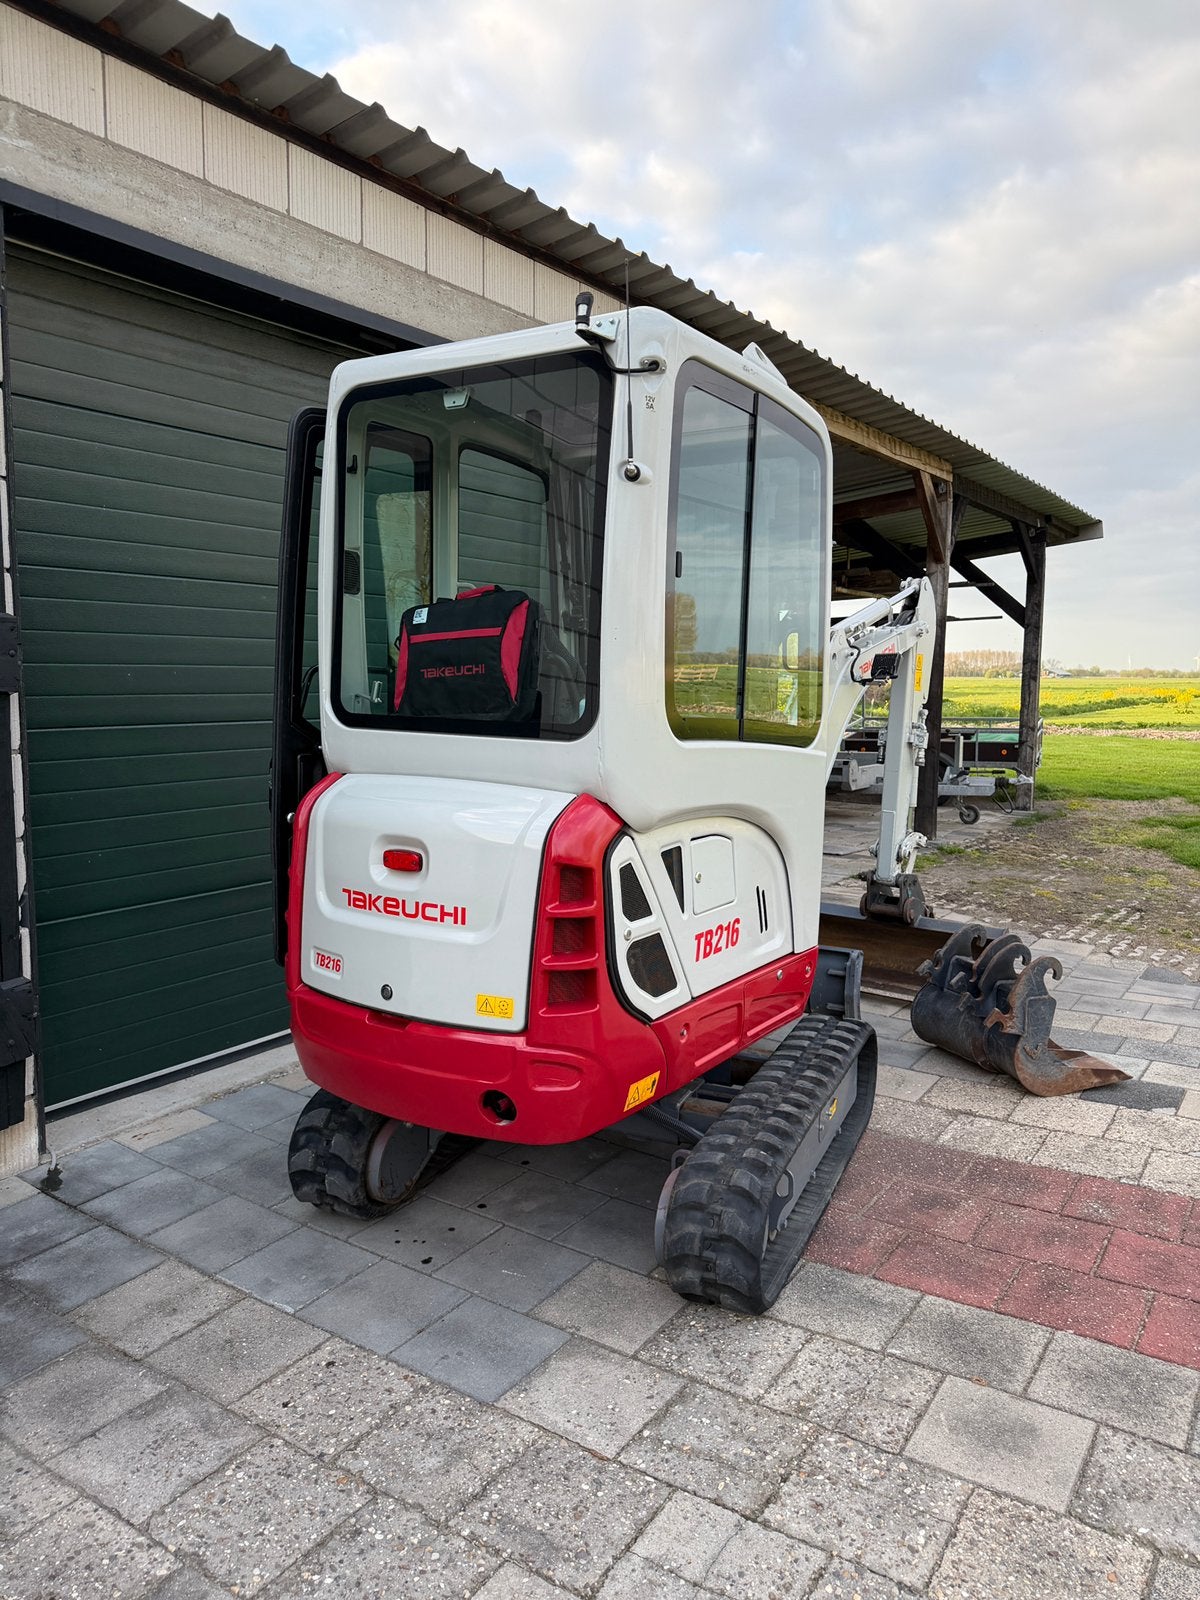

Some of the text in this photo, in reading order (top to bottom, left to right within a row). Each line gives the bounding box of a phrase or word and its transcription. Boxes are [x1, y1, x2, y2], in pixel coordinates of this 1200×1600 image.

[645, 395, 656, 403] 12V
[645, 402, 655, 410] 5A
[420, 663, 485, 679] TAKEUCHI
[342, 888, 467, 926] TAKEUCHI
[694, 917, 741, 963] TB216
[315, 952, 342, 973] TB216
